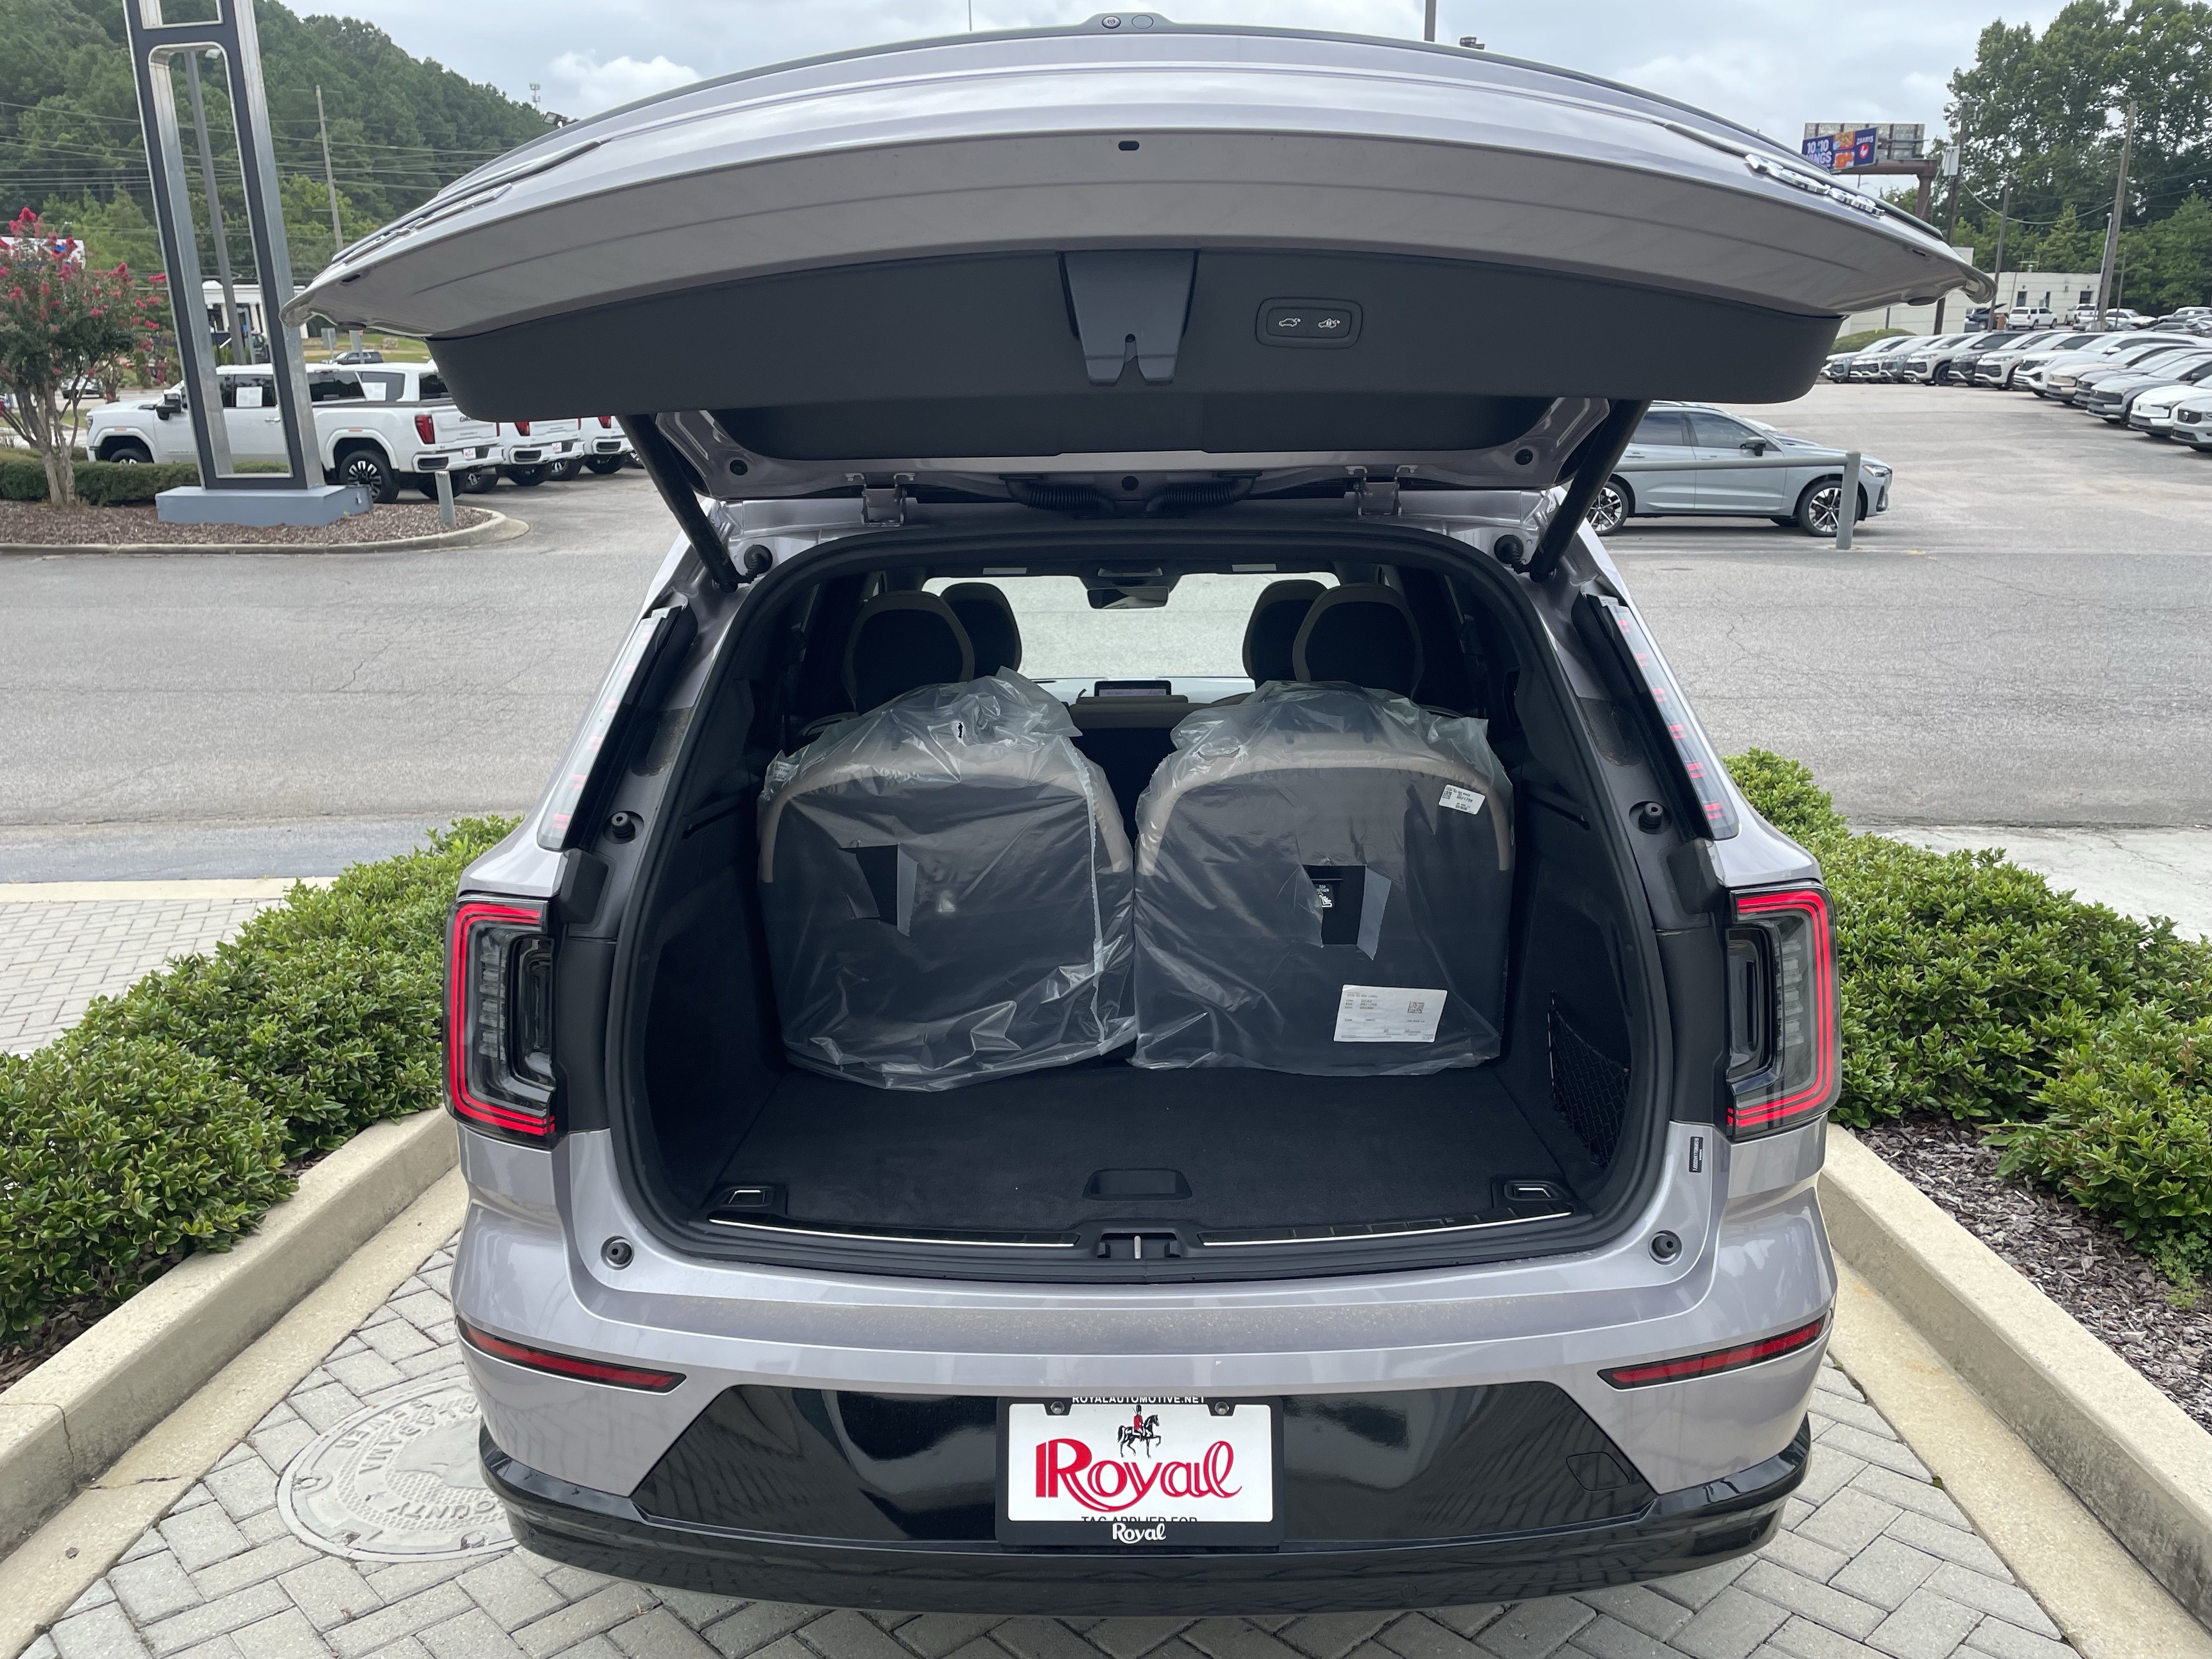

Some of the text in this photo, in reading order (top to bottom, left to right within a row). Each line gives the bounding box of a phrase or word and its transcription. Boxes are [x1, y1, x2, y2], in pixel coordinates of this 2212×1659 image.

[1807, 141, 1816, 154] 10
[1035, 1438, 1243, 1512] Royal
[386, 1501, 496, 1519] OUNTY
[1112, 1522, 1166, 1544] Royal
